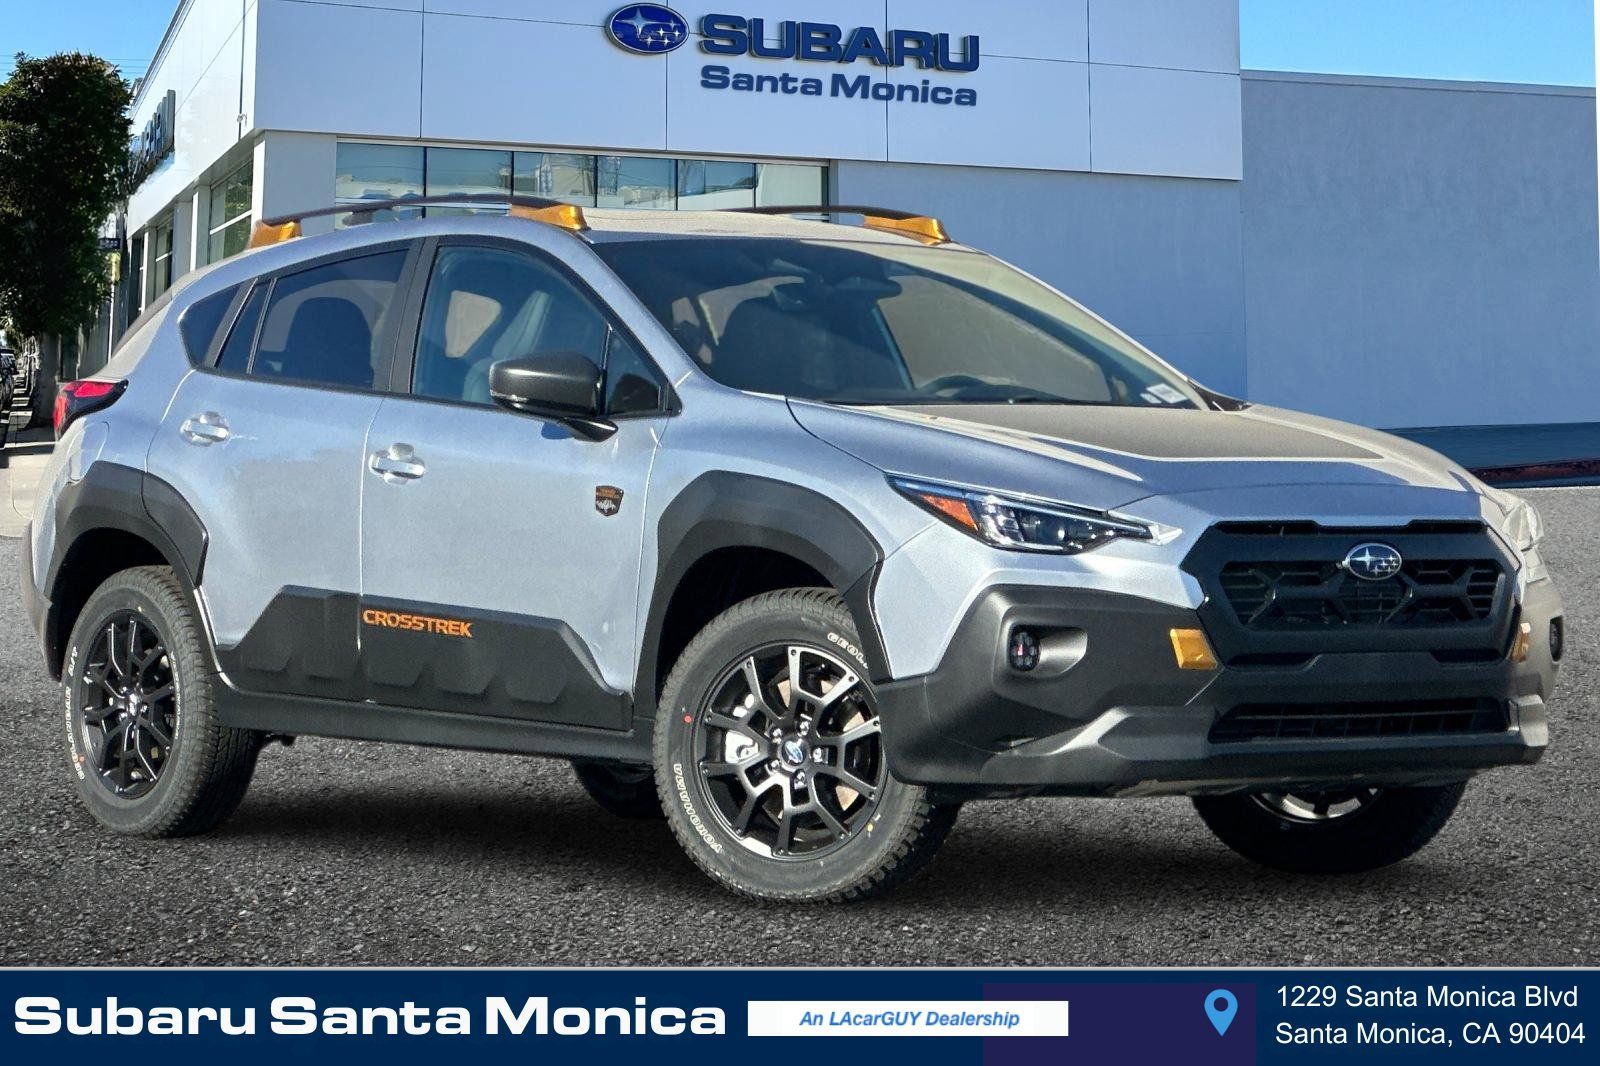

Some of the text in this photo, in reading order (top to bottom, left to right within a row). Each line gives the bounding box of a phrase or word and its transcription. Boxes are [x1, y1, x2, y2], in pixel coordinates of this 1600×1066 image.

[701, 13, 980, 72] SUBARU
[700, 64, 977, 107] Santa Monica
[362, 609, 472, 638] CROSSTREK
[673, 763, 724, 854] YOKOHAMA
